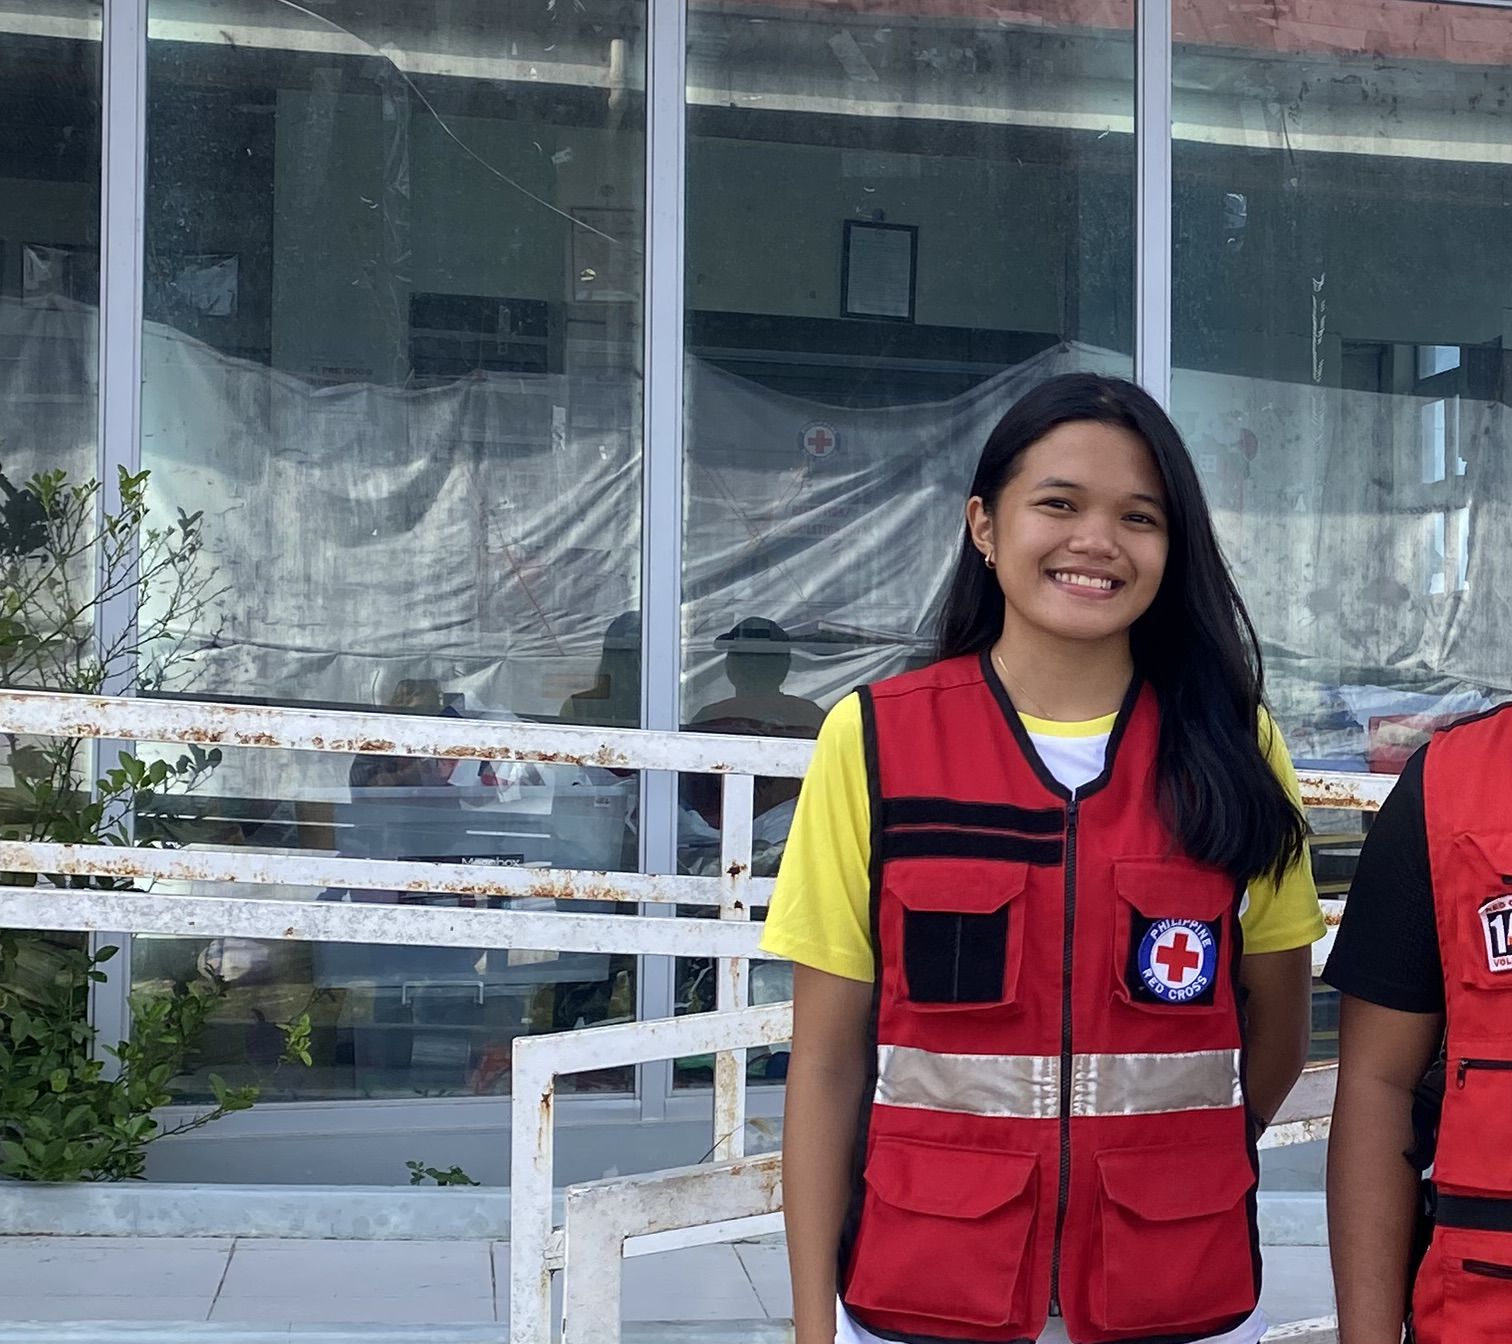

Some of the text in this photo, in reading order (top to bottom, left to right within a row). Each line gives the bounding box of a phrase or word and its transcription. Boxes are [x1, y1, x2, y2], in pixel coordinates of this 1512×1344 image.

[1486, 901, 1506, 913] RED
[1150, 919, 1212, 948] PHILIPPINE
[1142, 967, 1208, 1000] RED CROSS
